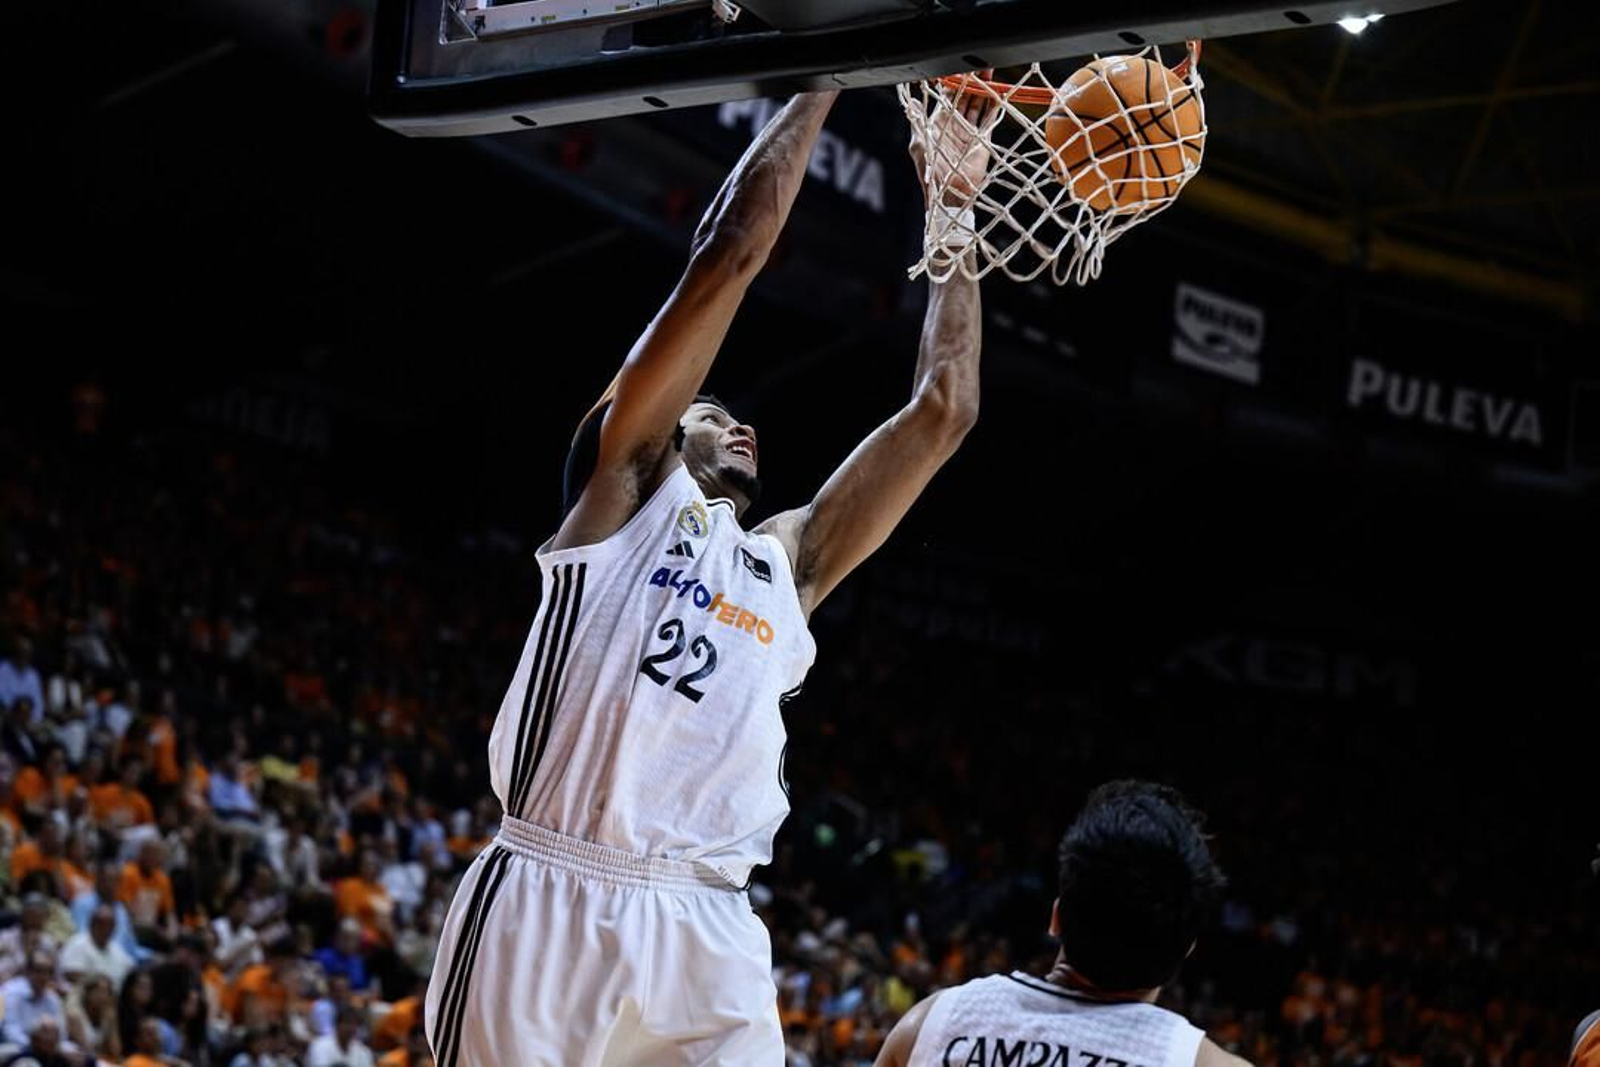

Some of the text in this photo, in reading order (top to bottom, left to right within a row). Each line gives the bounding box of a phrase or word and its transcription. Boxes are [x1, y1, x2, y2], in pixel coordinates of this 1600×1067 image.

[1347, 356, 1543, 447] PULEVA
[640, 618, 718, 703] 22
[942, 1036, 1144, 1067] CAMPA
